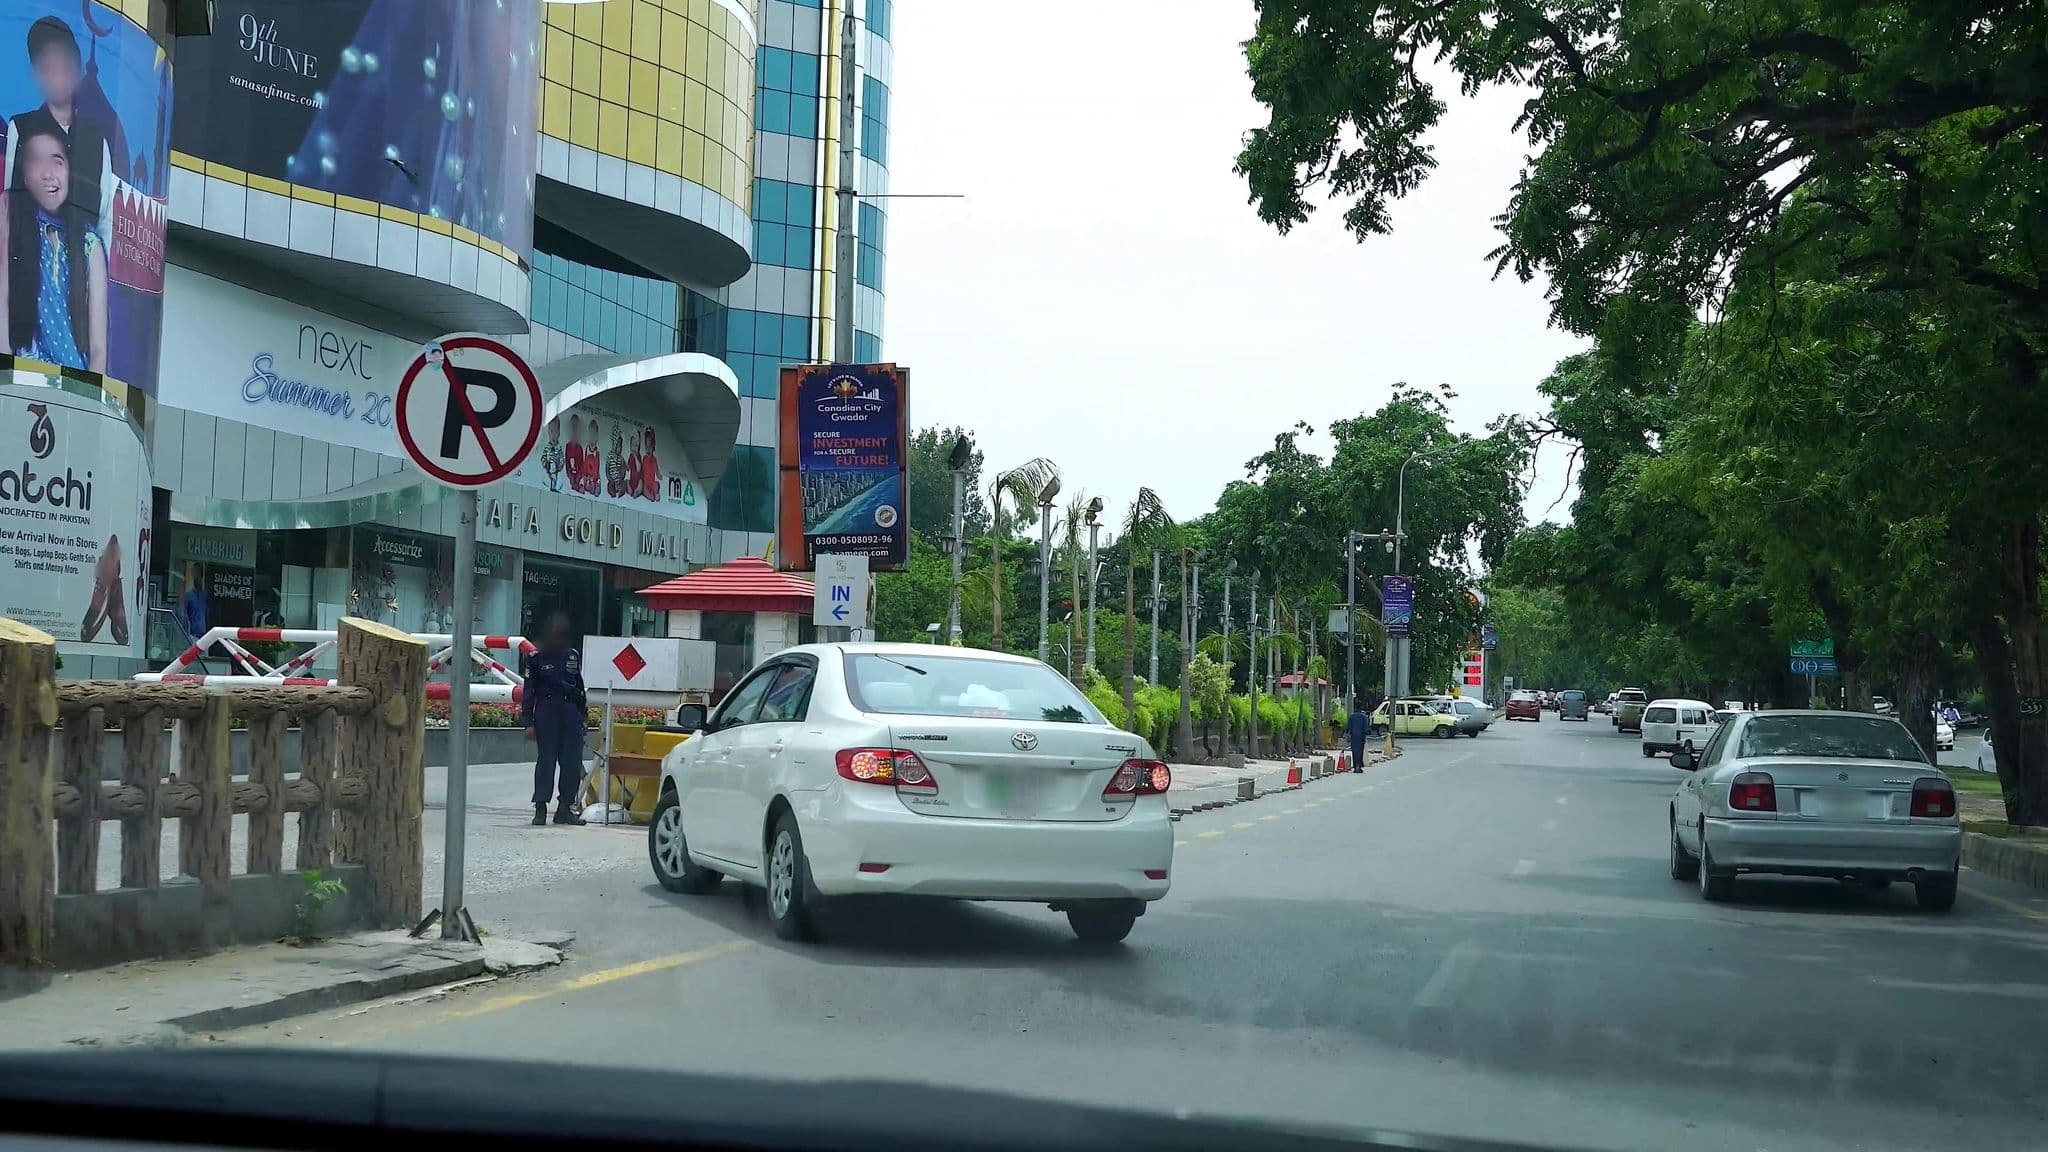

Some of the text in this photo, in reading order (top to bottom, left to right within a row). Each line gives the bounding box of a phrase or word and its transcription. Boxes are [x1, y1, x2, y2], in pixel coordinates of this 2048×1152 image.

[239, 13, 277, 51] 9th
[253, 39, 318, 79] JUNE
[229, 74, 323, 110] sanasafinaz.com
[118, 215, 136, 239] EID
[298, 323, 373, 380] next
[242, 352, 355, 419] Summer
[440, 366, 516, 460] P
[817, 403, 882, 413] Canadian City
[831, 412, 868, 422] Gwadar
[813, 431, 841, 439] SECURE
[813, 437, 888, 449] INVESTMENT
[829, 448, 856, 456] SECURE
[836, 454, 889, 466] FUTURE!
[0, 460, 92, 512] atchi
[49, 512, 58, 521] IN
[59, 513, 91, 526] PAKISTAN
[16, 529, 46, 543] Arrival
[48, 533, 65, 545] Now
[67, 535, 74, 547] in
[76, 536, 98, 549] Stores
[373, 534, 423, 558] Accessorize
[561, 513, 623, 549] GOLD
[639, 528, 693, 562] MALL
[815, 535, 893, 545] 0300-0508092-96
[14, 559, 32, 570] Shirts
[831, 585, 850, 601] IN
